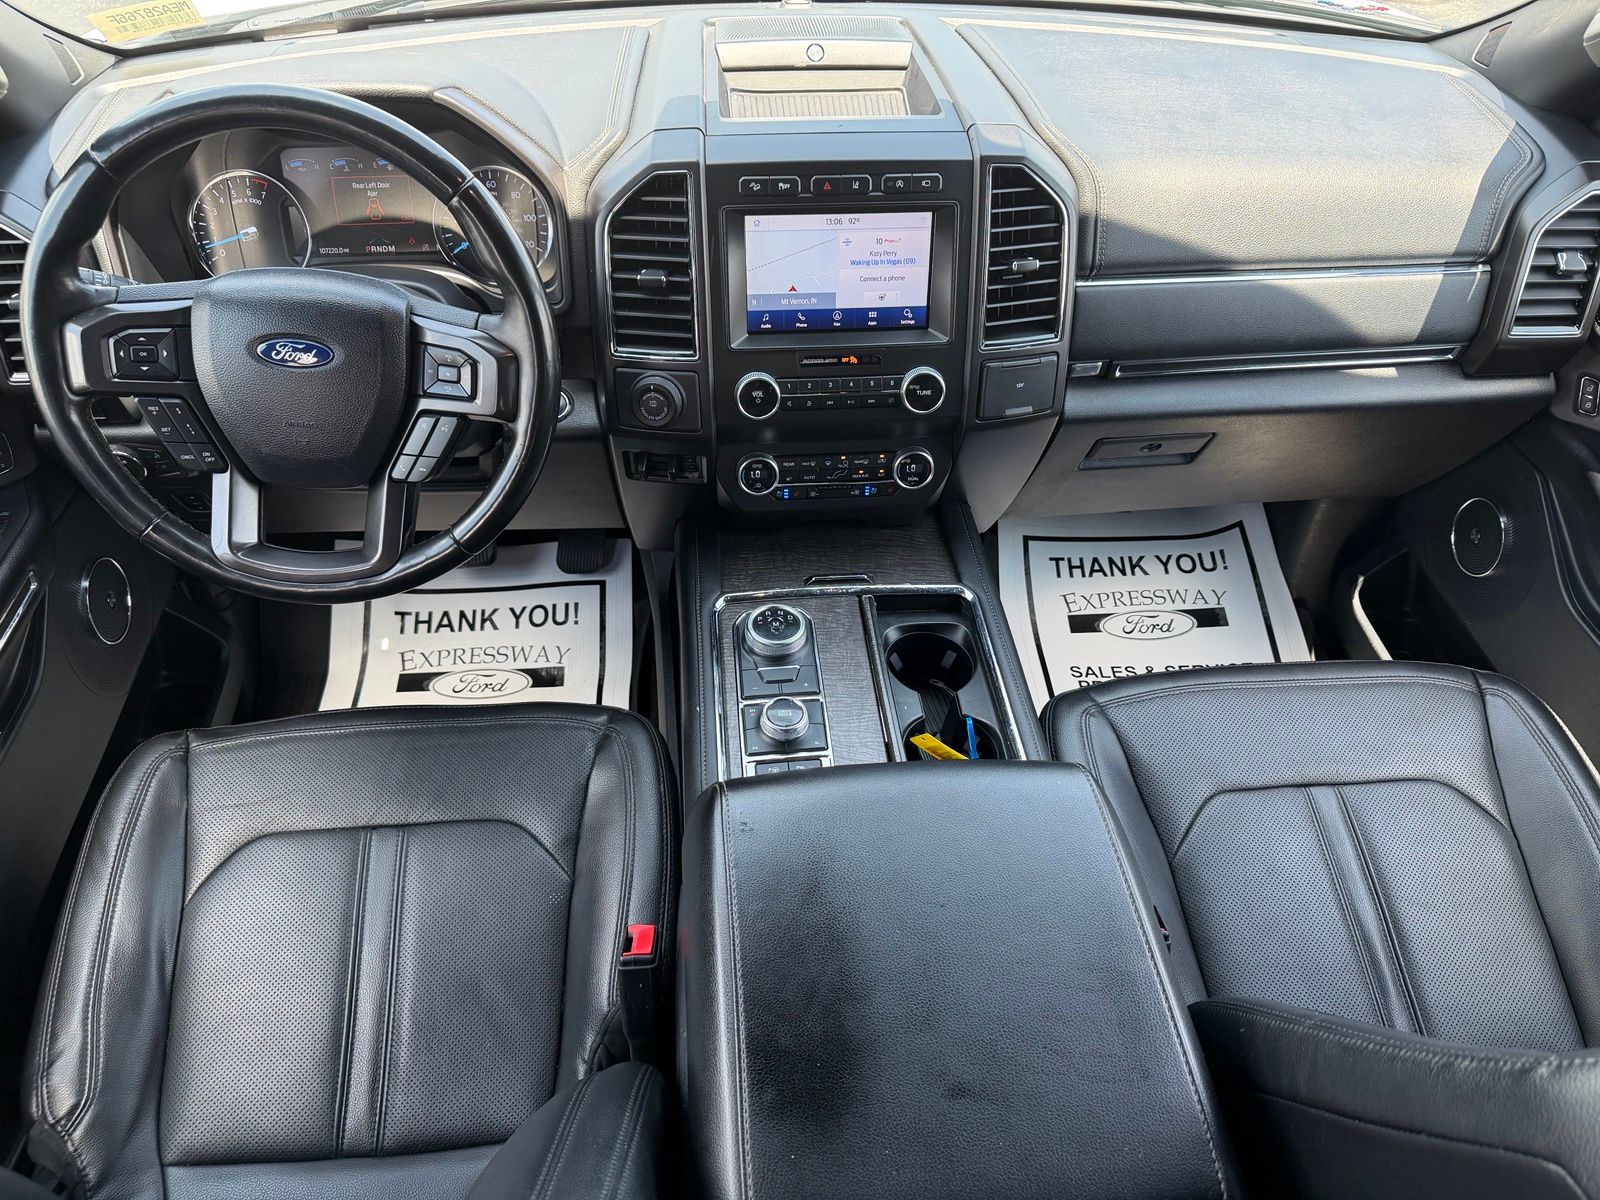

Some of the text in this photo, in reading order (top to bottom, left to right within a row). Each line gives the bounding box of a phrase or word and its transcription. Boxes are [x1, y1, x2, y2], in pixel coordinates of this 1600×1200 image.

[486, 180, 496, 188] 60
[272, 342, 318, 364] Ford
[1048, 549, 1228, 578] THANK YOU!
[1060, 588, 1227, 614] EXPRESSWAY
[394, 602, 580, 635] THANK YOU!
[1122, 615, 1175, 634] Ford
[398, 646, 571, 672] EXPRESSWAY
[1070, 666, 1138, 678] SALES
[452, 674, 508, 694] Ford
